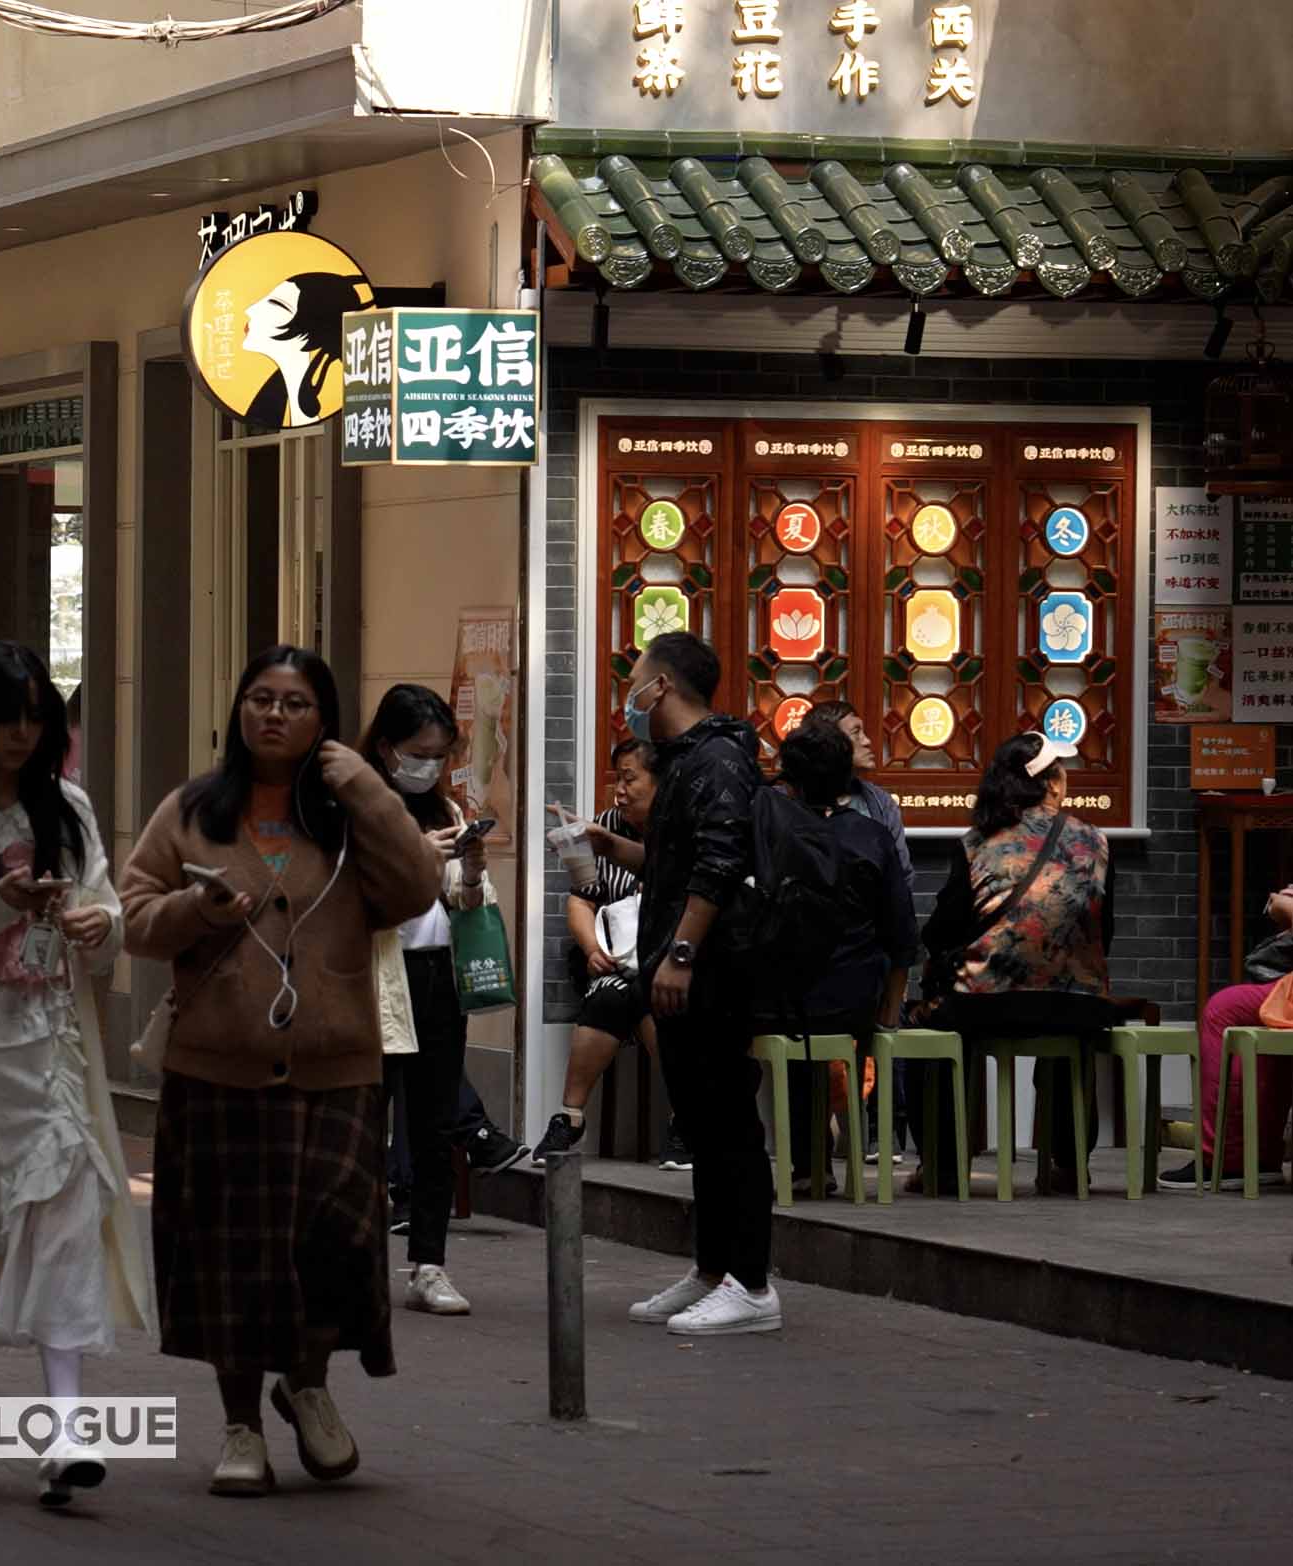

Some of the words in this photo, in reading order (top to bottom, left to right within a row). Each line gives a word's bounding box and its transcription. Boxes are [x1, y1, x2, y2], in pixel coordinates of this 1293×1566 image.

[733, 0, 783, 97] 豆花
[830, 2, 881, 101] 手作
[926, 4, 976, 104] 西关
[344, 321, 392, 387] 亚信
[398, 321, 536, 387] 亚信
[442, 393, 466, 401] FOUR
[344, 407, 392, 449] 四季饮
[401, 406, 535, 450] 四季饮
[646, 510, 677, 541] 春
[783, 512, 813, 543] 夏
[917, 512, 949, 544] 秋
[1050, 516, 1083, 546] 冬
[1048, 711, 1078, 738] 梅
